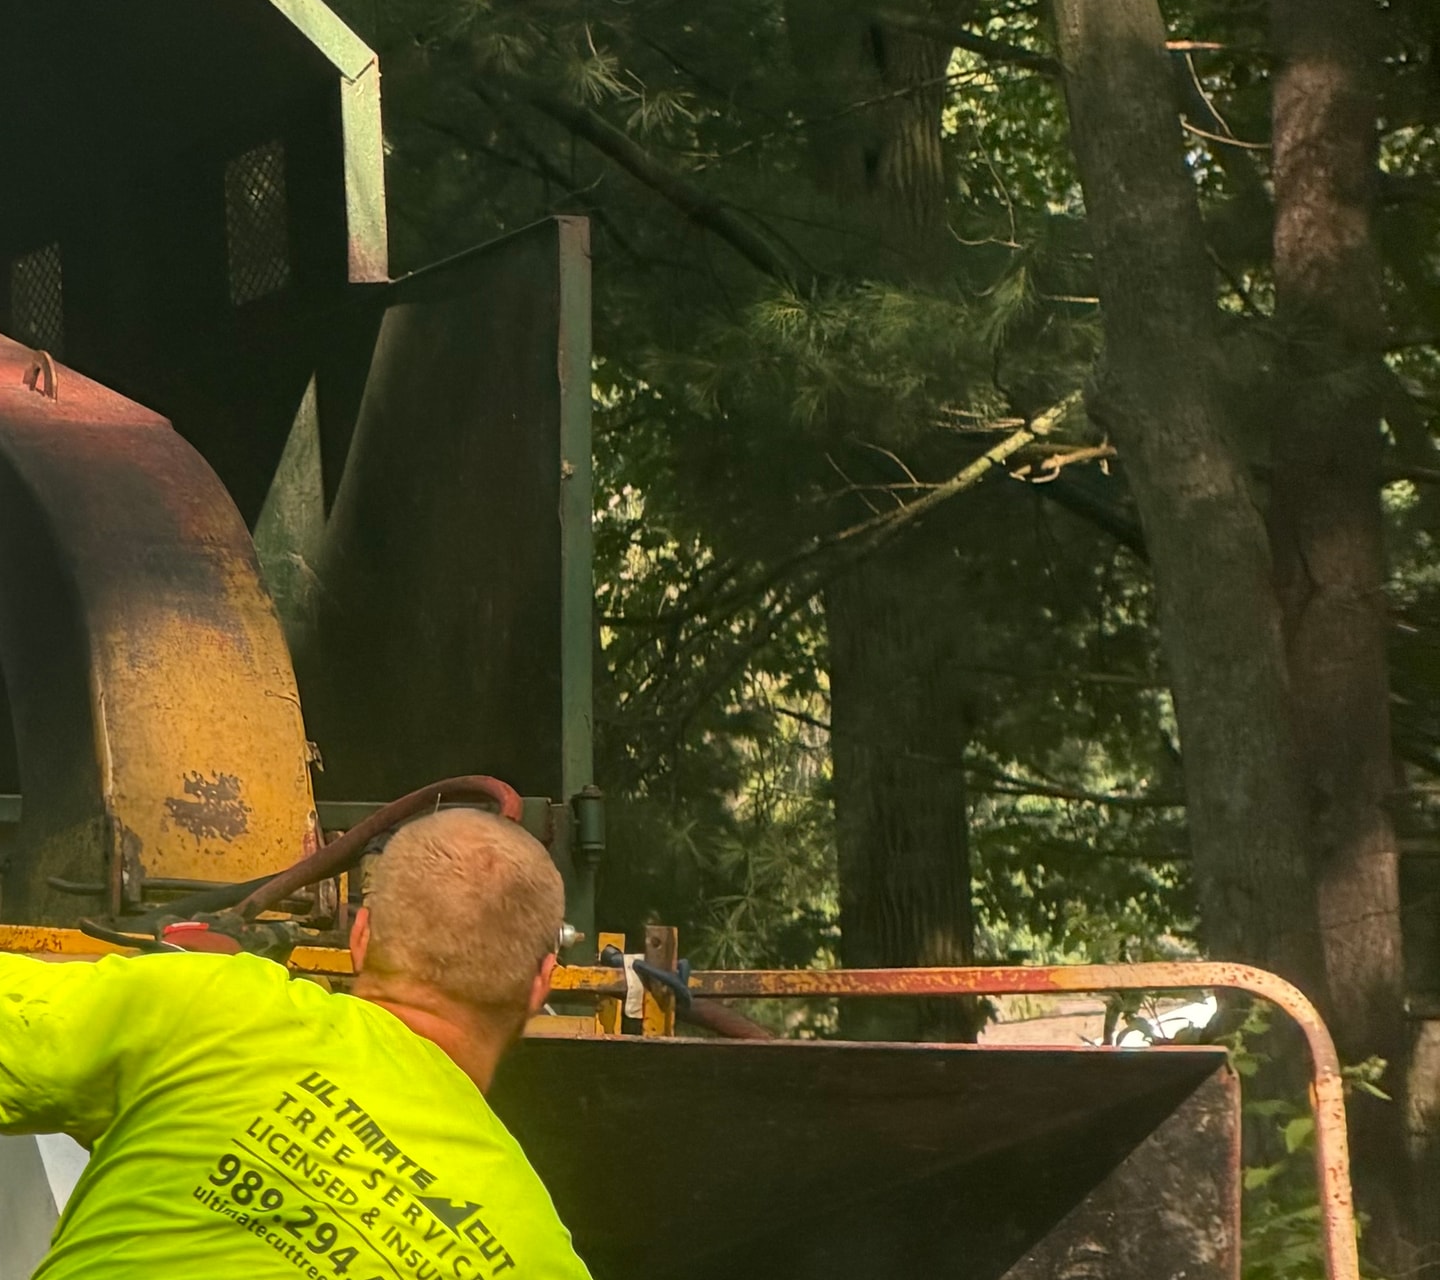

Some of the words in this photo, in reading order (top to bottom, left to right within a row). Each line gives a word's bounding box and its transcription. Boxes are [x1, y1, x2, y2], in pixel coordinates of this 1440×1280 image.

[246, 1117, 359, 1207] LICENSED
[360, 1207, 381, 1230] &
[273, 1091, 355, 1165] TREE
[297, 1072, 438, 1190] ULTIMATE
[464, 1219, 516, 1275] CUT
